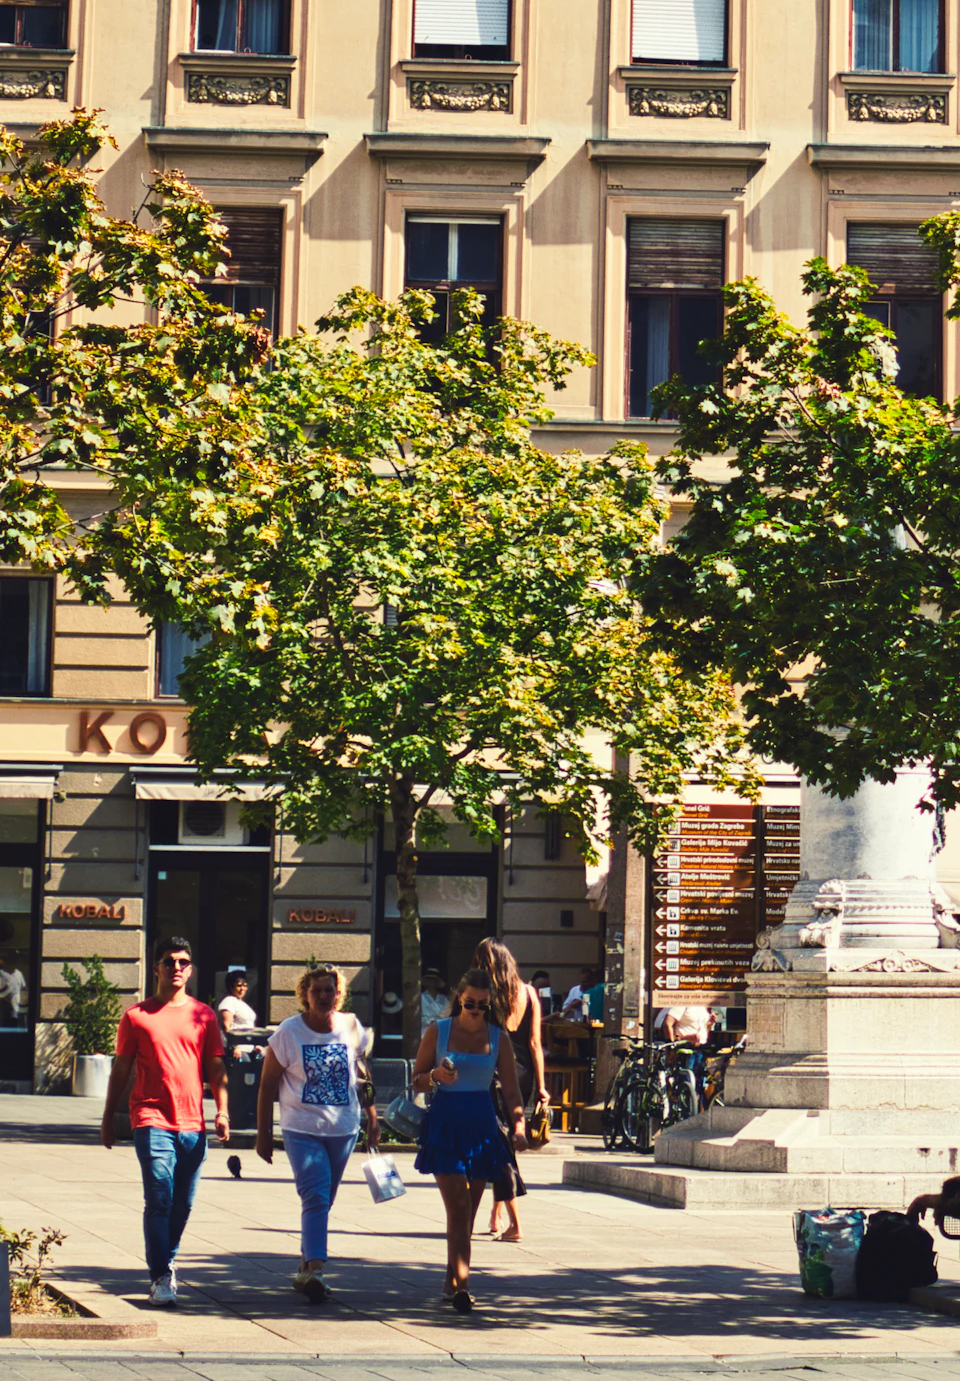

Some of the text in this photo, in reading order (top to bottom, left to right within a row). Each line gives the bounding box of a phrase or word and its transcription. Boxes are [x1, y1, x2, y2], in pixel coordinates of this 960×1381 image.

[681, 822, 745, 831] Muzej grada Zagreba
[766, 823, 785, 831] Muzej
[681, 839, 707, 847] Galerija
[766, 840, 784, 848] Muzej
[59, 904, 127, 920] KOBALI
[288, 907, 357, 923] KOBALI
[679, 958, 700, 966] Muzej
